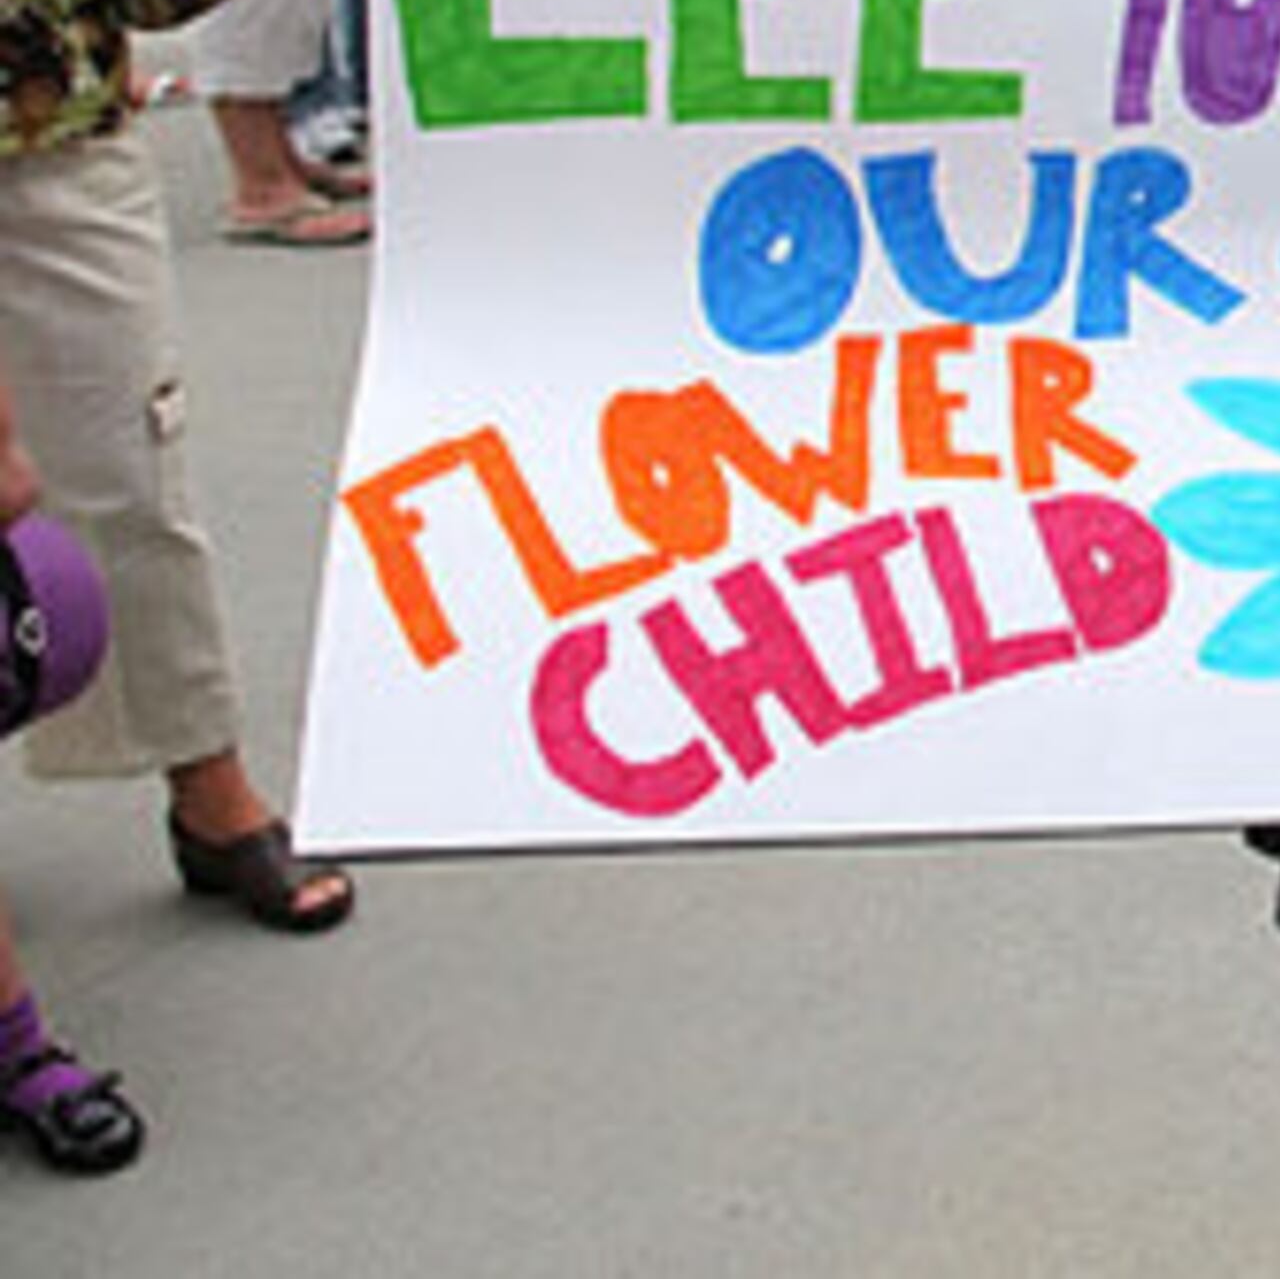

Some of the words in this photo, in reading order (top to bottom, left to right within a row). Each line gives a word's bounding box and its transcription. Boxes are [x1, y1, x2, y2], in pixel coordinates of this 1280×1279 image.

[699, 146, 1245, 355] OUR
[340, 325, 1139, 671] FLOWER
[529, 491, 1174, 818] CHILD
